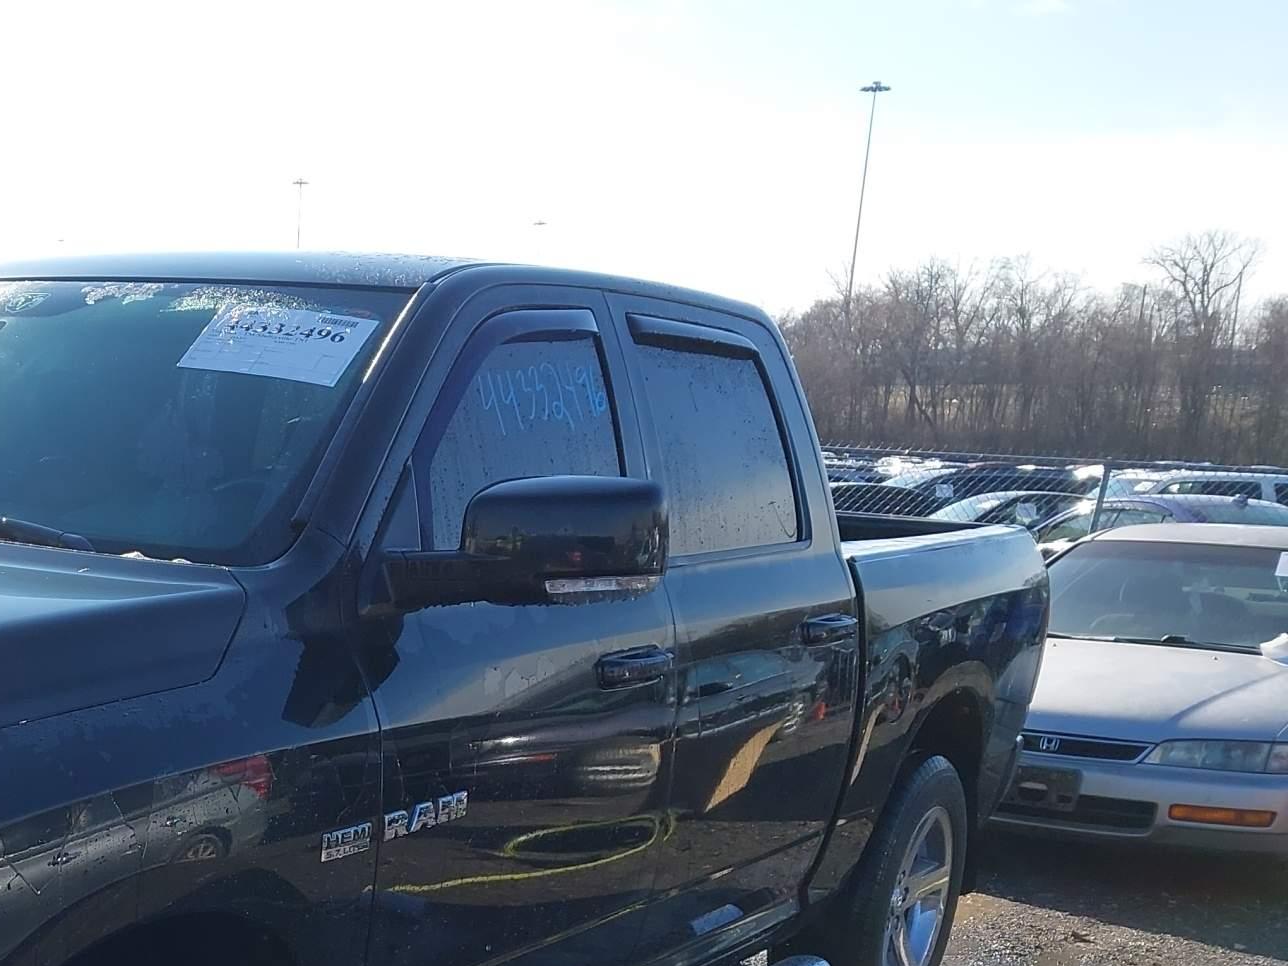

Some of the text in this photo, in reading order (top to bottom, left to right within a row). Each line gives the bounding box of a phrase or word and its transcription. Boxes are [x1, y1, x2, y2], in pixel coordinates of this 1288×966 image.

[478, 361, 607, 436] 44332496
[322, 822, 372, 850] HEMI
[383, 789, 469, 842] RAM
